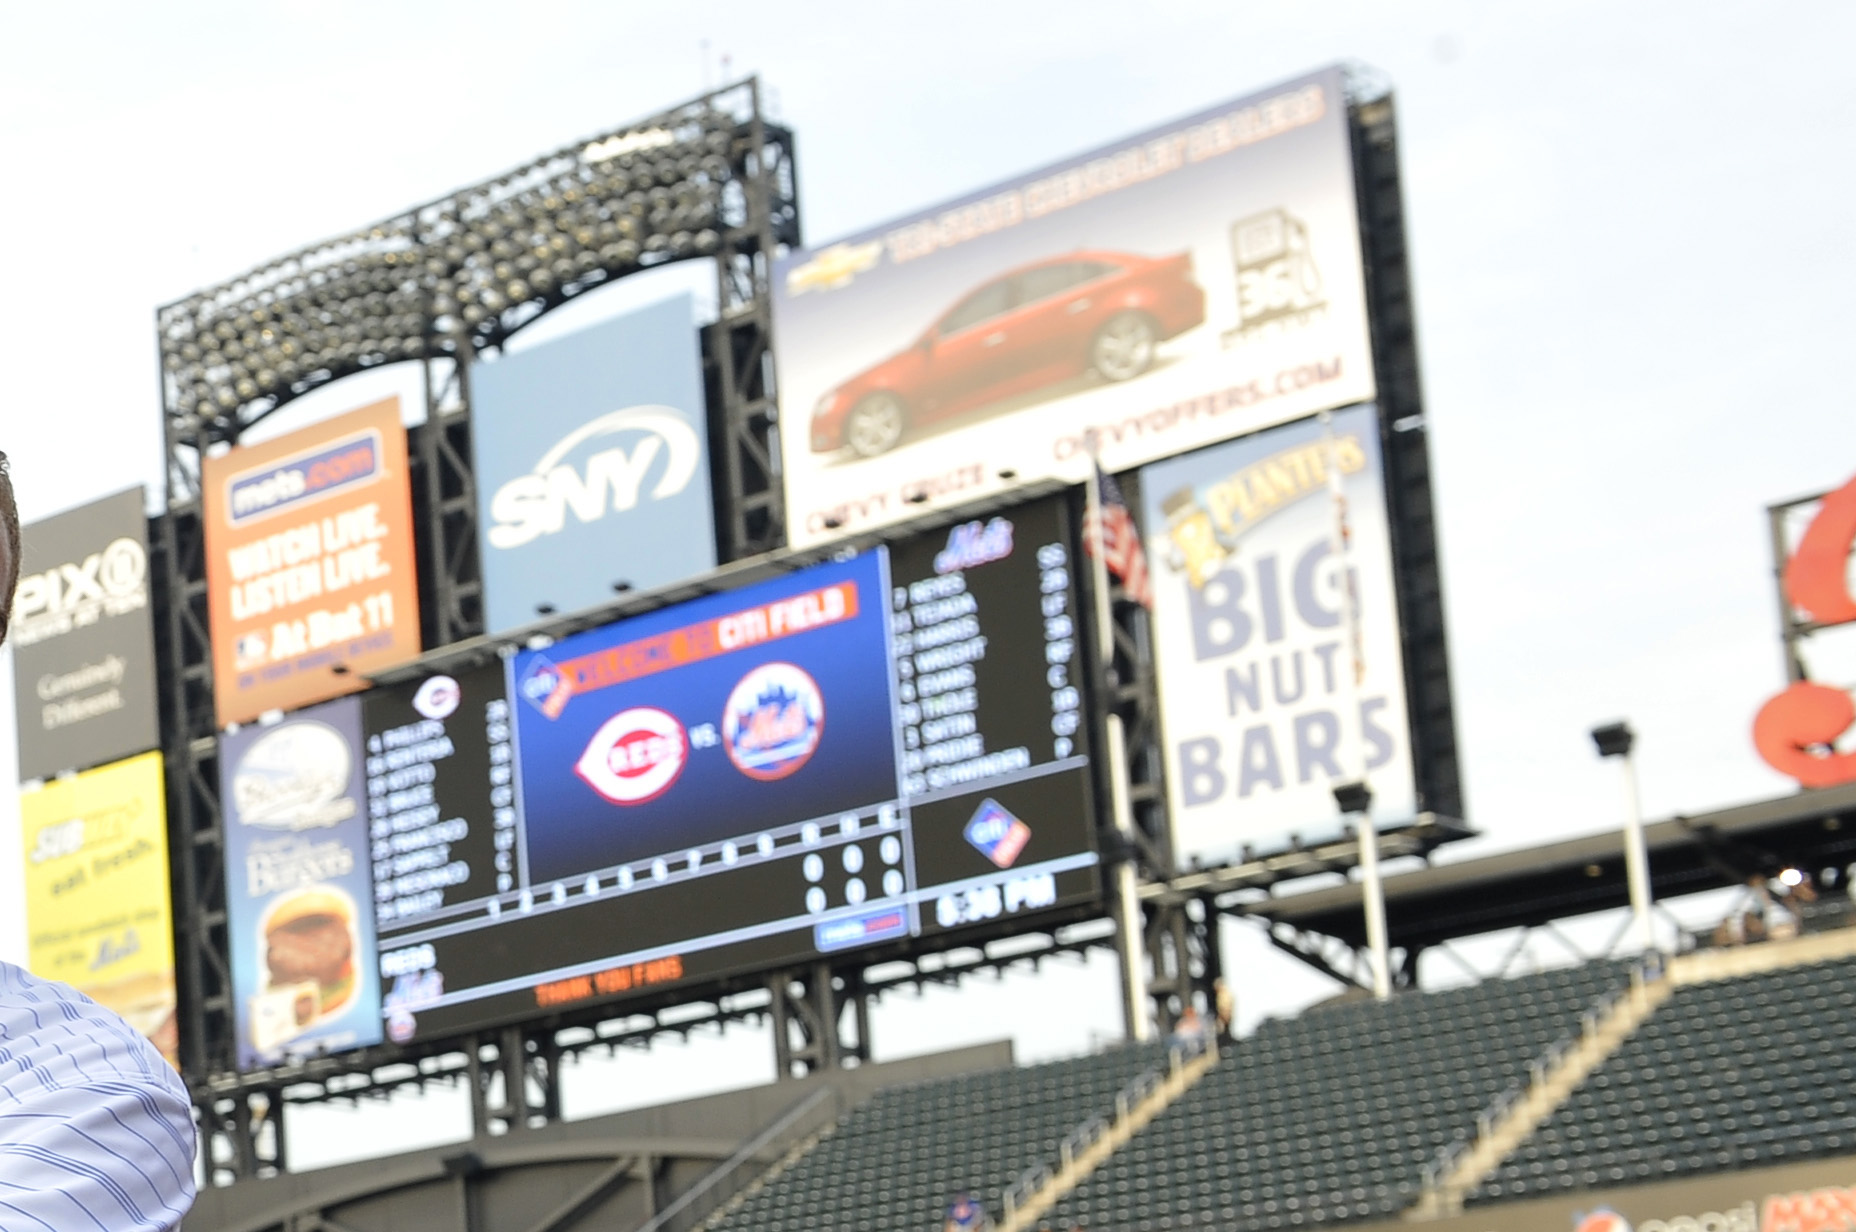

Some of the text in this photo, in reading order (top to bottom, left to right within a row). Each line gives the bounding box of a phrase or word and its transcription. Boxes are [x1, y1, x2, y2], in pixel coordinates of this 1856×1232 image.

[488, 434, 664, 550] SNY
[1186, 537, 1362, 662] BIG
[1225, 641, 1342, 718] NUT
[1177, 696, 1396, 808] BARS
